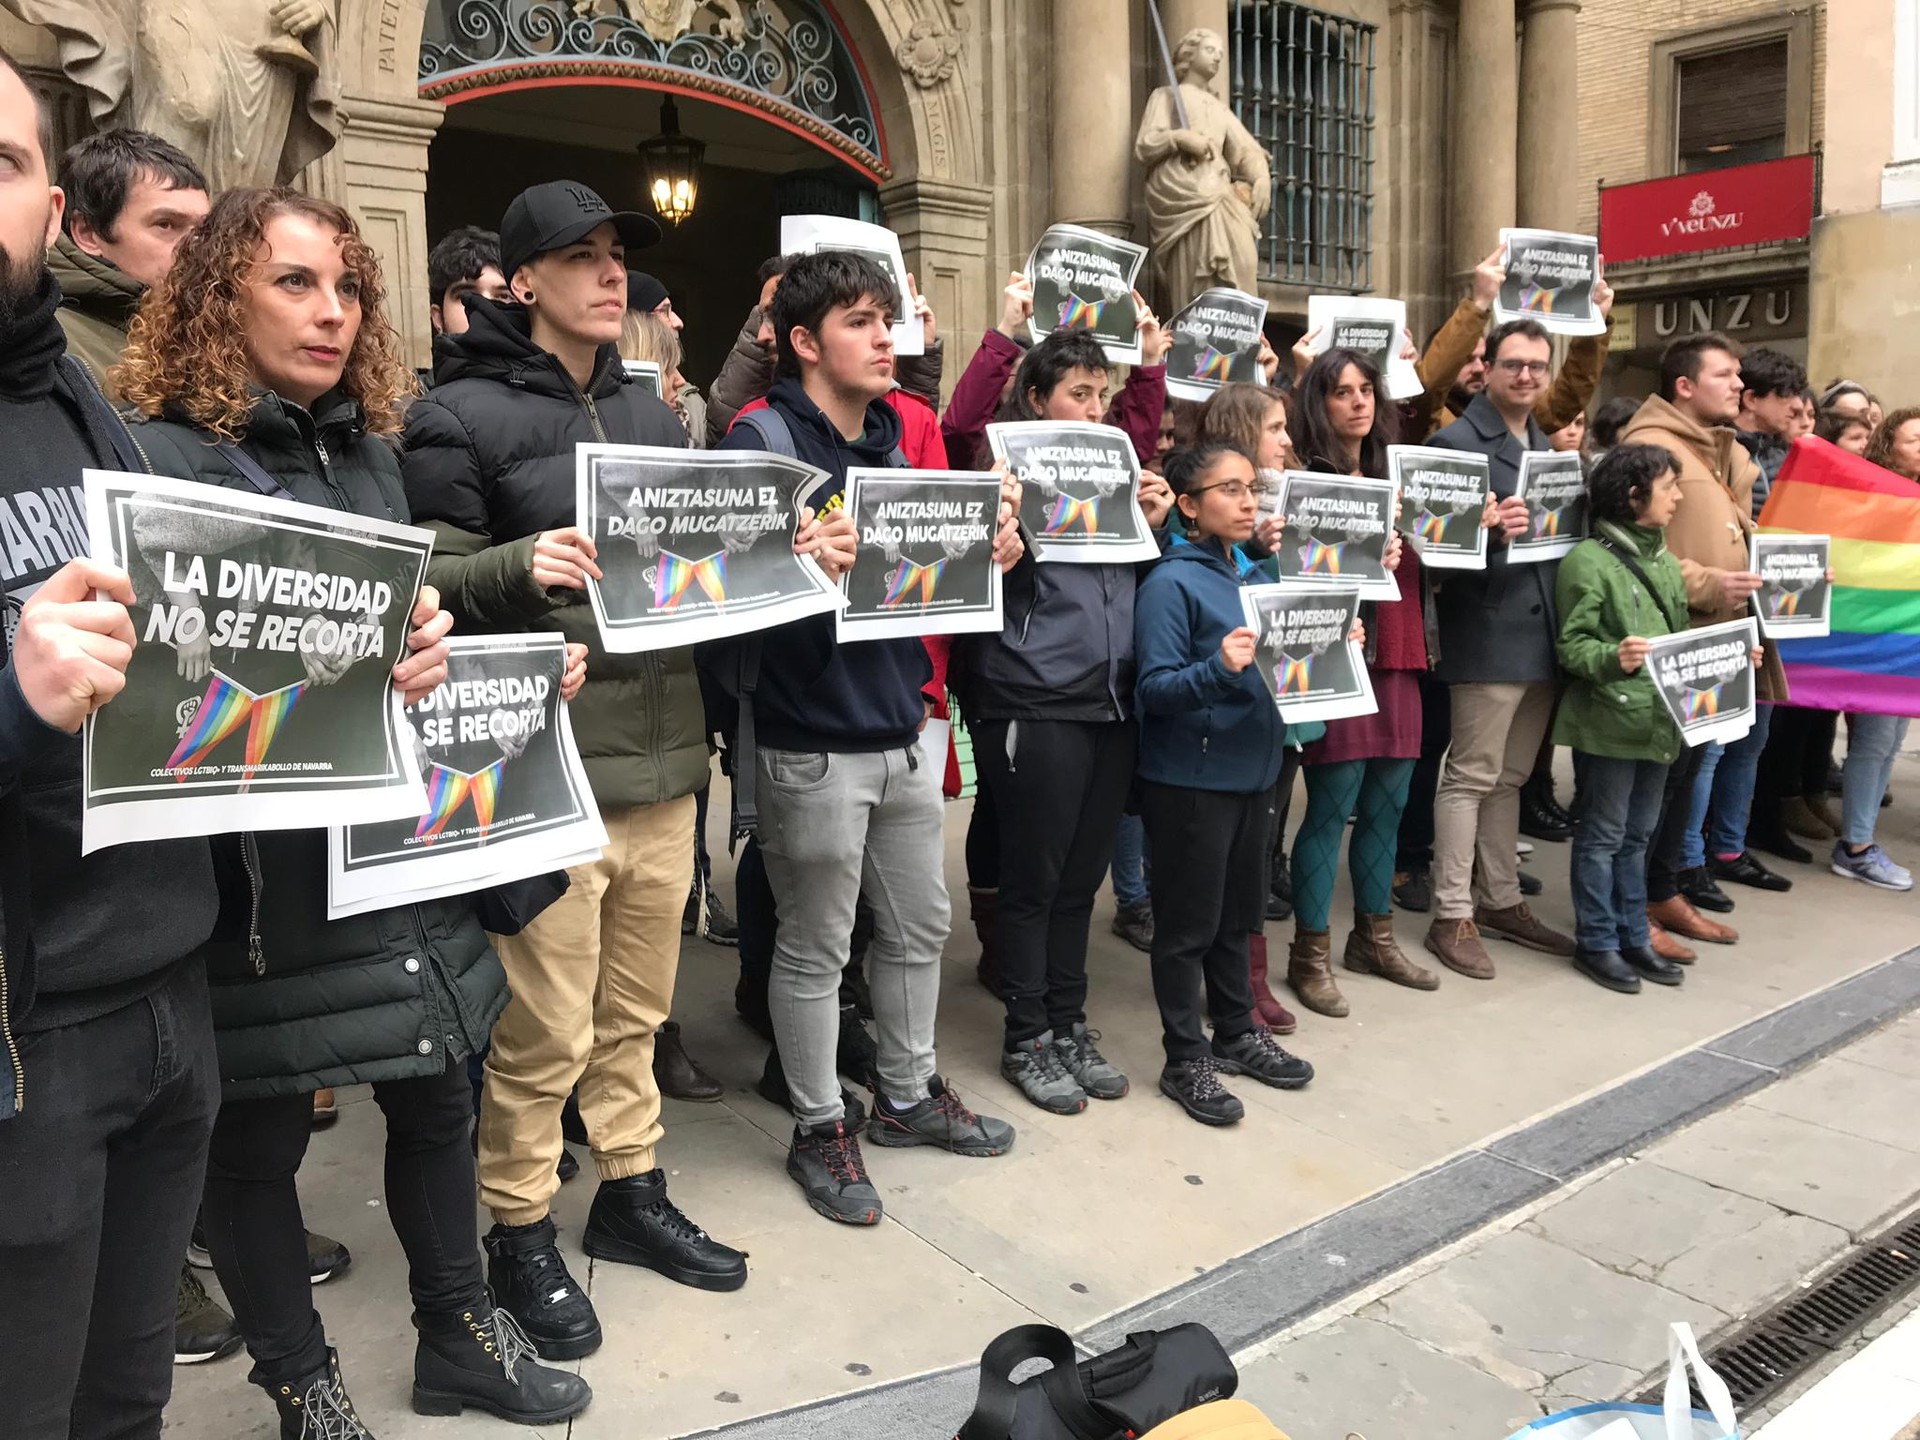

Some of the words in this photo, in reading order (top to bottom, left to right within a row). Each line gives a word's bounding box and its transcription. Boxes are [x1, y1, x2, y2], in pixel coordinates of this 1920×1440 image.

[927, 101, 946, 167] MAGIS
[1051, 248, 1112, 271] ANIZTASUNA
[1522, 248, 1578, 265] ANIZTASUNA
[1041, 265, 1074, 282] DAGO
[1511, 262, 1538, 275] DAGO
[1187, 306, 1251, 326] ANIZTASUNA
[1655, 290, 1790, 336] UNZU
[1176, 320, 1212, 335] DAGO
[1340, 328, 1349, 337] LA
[1350, 328, 1388, 338] DIVERSIDAD
[1336, 338, 1348, 348] NO
[1349, 339, 1357, 347] SE
[1026, 447, 1107, 463] ANIZTASUNA
[1107, 450, 1122, 465] EZ
[1018, 466, 1057, 481] DAGO
[1411, 470, 1467, 487] ANIZTASUNA
[1469, 476, 1482, 488] EZ
[627, 487, 754, 508] ANIZTASUNA
[758, 486, 778, 506] EZ
[1404, 486, 1429, 499] DAGO
[876, 502, 962, 519] ANIZTASUNA
[965, 502, 983, 517] EZ
[1300, 497, 1365, 515] ANIZTASUNA
[1366, 502, 1379, 515] EZ
[608, 515, 667, 536] DAGO
[669, 512, 790, 534] MUGATZERIK
[1287, 514, 1319, 527] DAGO
[1319, 516, 1385, 533] MUGATZERIK
[863, 526, 904, 544] DAGO
[906, 524, 990, 543] MUGATZERIK
[163, 551, 208, 596] LA
[217, 559, 391, 615] DIVERSIDAD
[1270, 610, 1285, 627] LA
[1287, 608, 1347, 627] DIVERSIDAD
[144, 604, 206, 645] NO
[209, 608, 257, 649] SE
[257, 614, 384, 658] RECORTA
[1264, 631, 1283, 646] NO
[1284, 631, 1298, 645] SE
[1297, 627, 1342, 644] RECORTA
[1661, 656, 1677, 671] LA
[1678, 640, 1745, 667] DIVERSIDAD
[1662, 670, 1680, 687] NO
[1681, 666, 1696, 681] SE
[1698, 655, 1748, 679] RECORTA
[418, 675, 549, 712] DIVERSIDAD
[423, 717, 454, 747] SE
[459, 707, 546, 743] RECORTA
[150, 767, 193, 777] COLECTIVOS
[292, 763, 302, 771] DE
[302, 762, 333, 771] NAVARRA
[404, 834, 438, 845] COLECTIVOS
